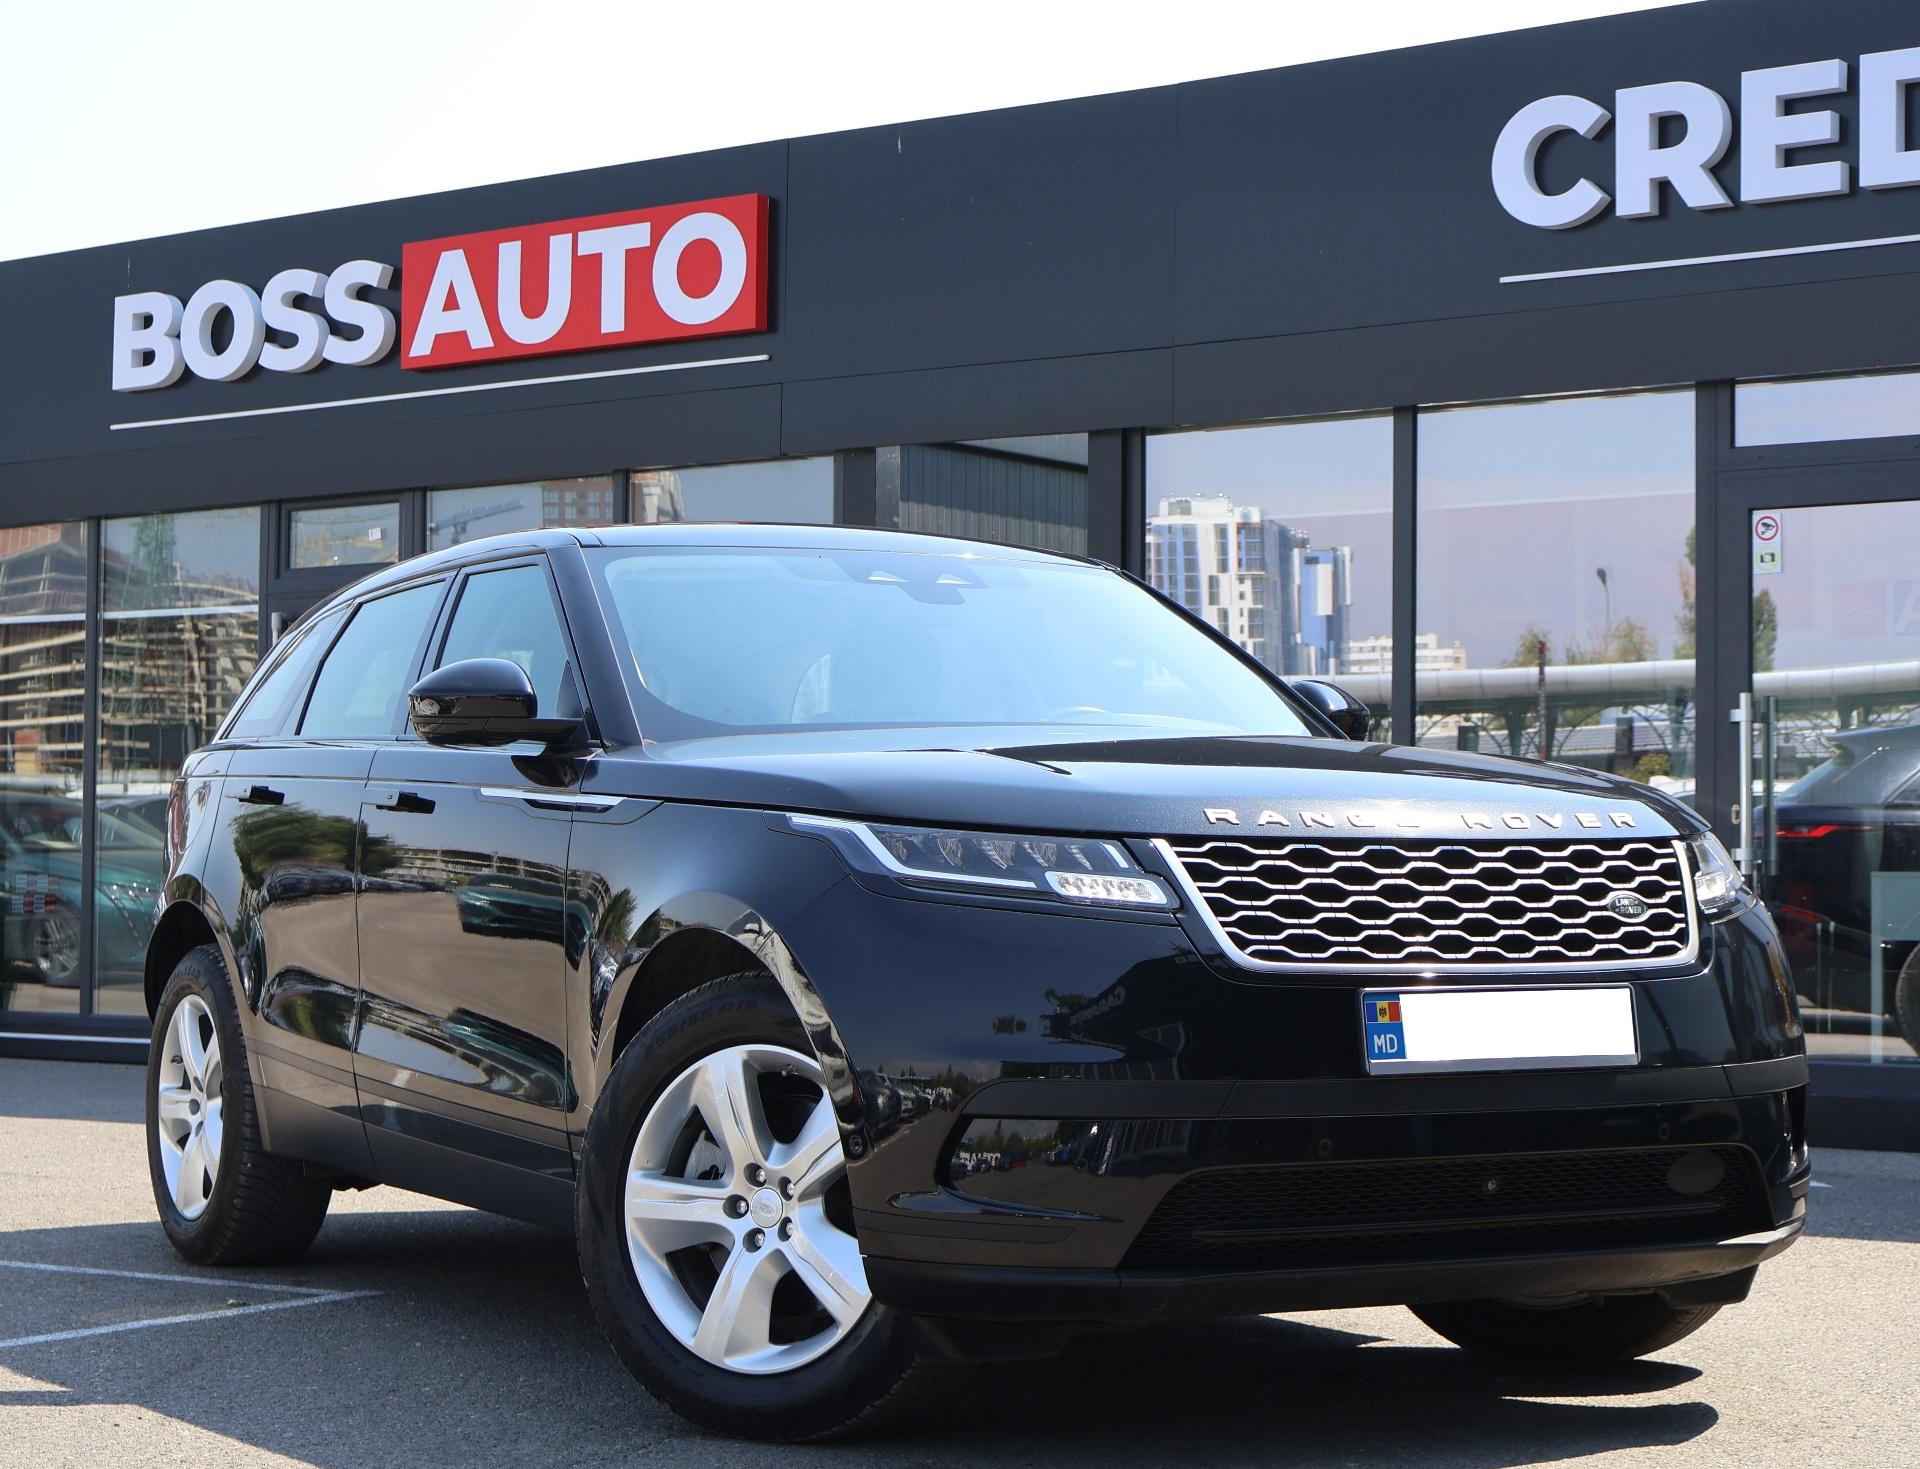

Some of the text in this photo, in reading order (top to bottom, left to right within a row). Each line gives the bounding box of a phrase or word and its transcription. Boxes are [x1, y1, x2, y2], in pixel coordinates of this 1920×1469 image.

[112, 211, 748, 392] BOSS AUTO
[1460, 811, 1638, 829] ROVER
[1615, 898, 1635, 906] LAND
[1619, 905, 1642, 914] ROVER
[1373, 1033, 1398, 1054] MD
